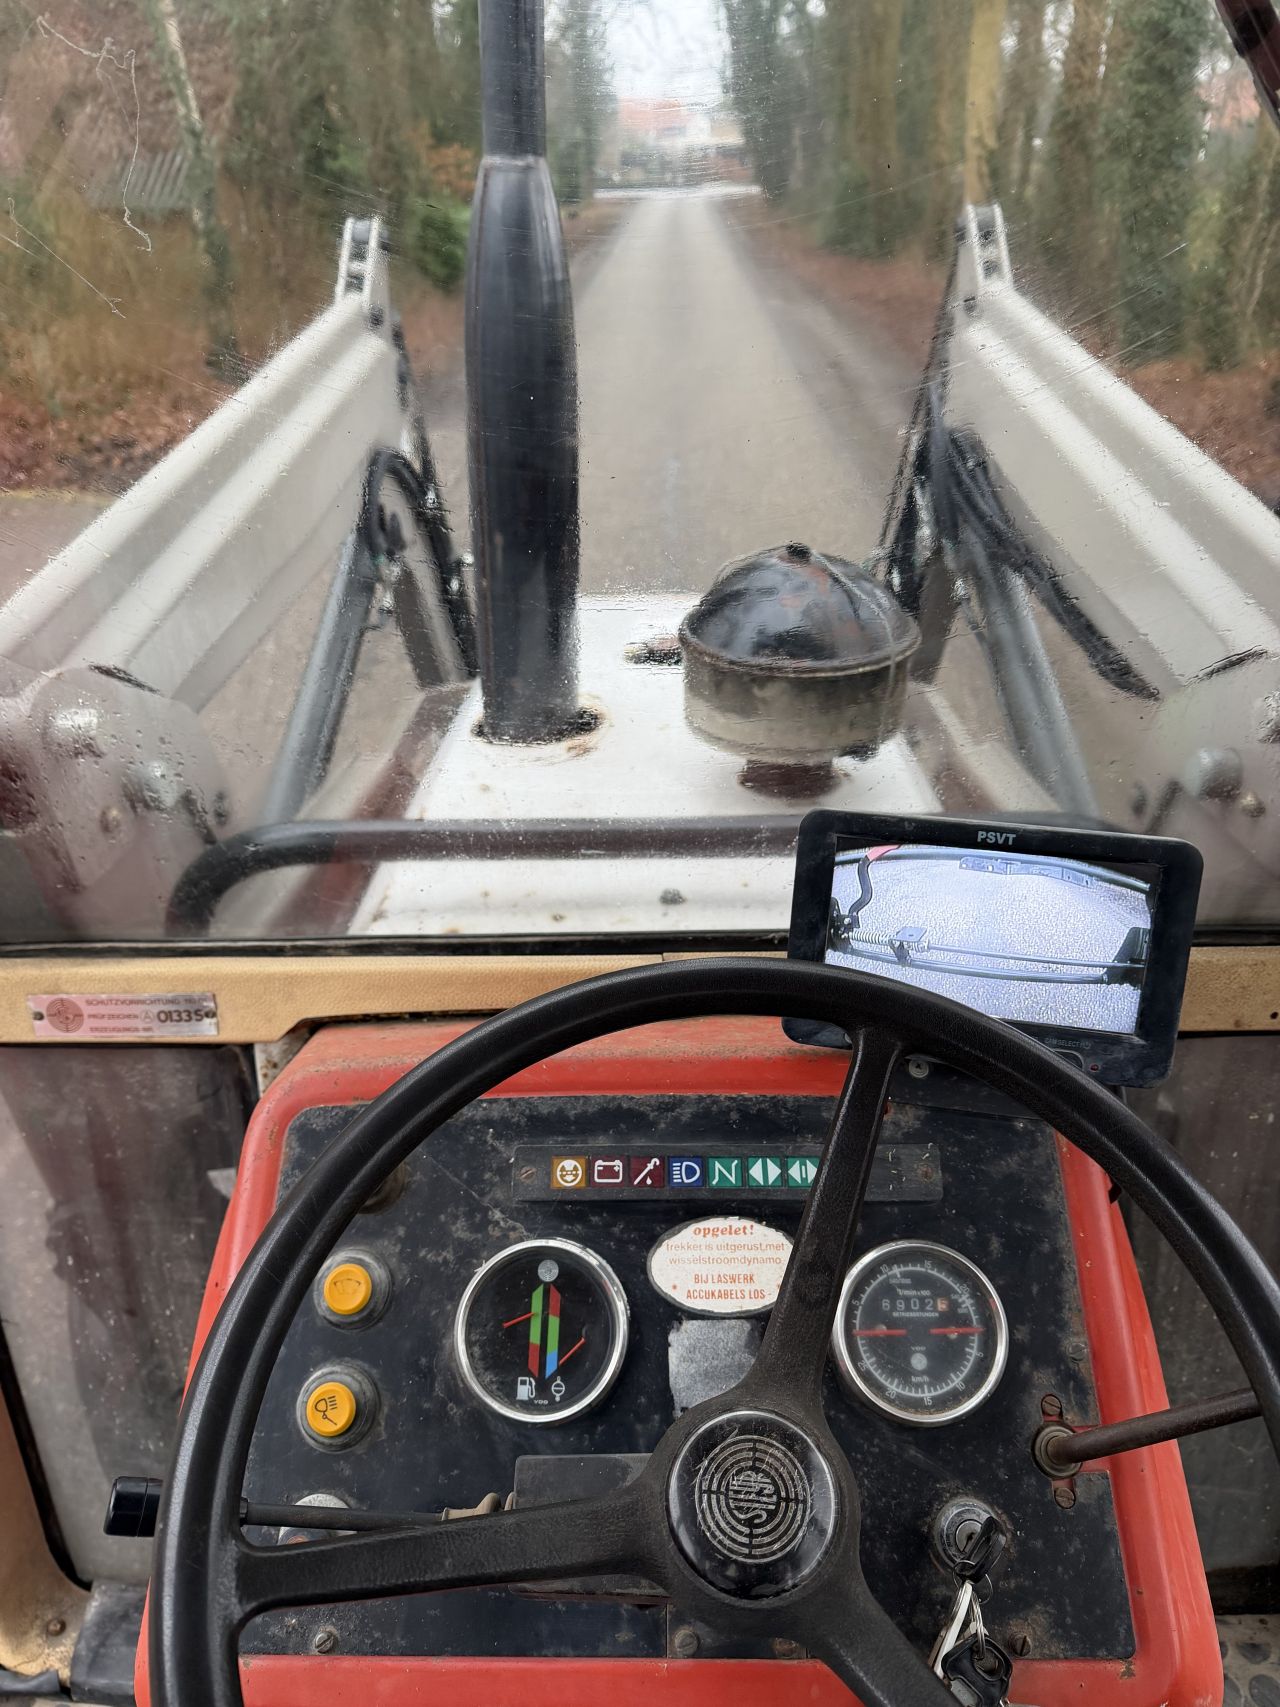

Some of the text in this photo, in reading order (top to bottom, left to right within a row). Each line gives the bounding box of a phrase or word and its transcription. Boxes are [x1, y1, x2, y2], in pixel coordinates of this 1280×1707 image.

[977, 830, 1017, 845] PSVT
[693, 1224, 755, 1238] opgelet!
[666, 1241, 785, 1254] trekker is uitgerust met
[711, 1273, 756, 1284] LASWERK
[686, 1289, 746, 1300] ACCUKABELS
[911, 1375, 929, 1383] km/h
[885, 1389, 897, 1399] 20
[924, 1397, 933, 1406] 15
